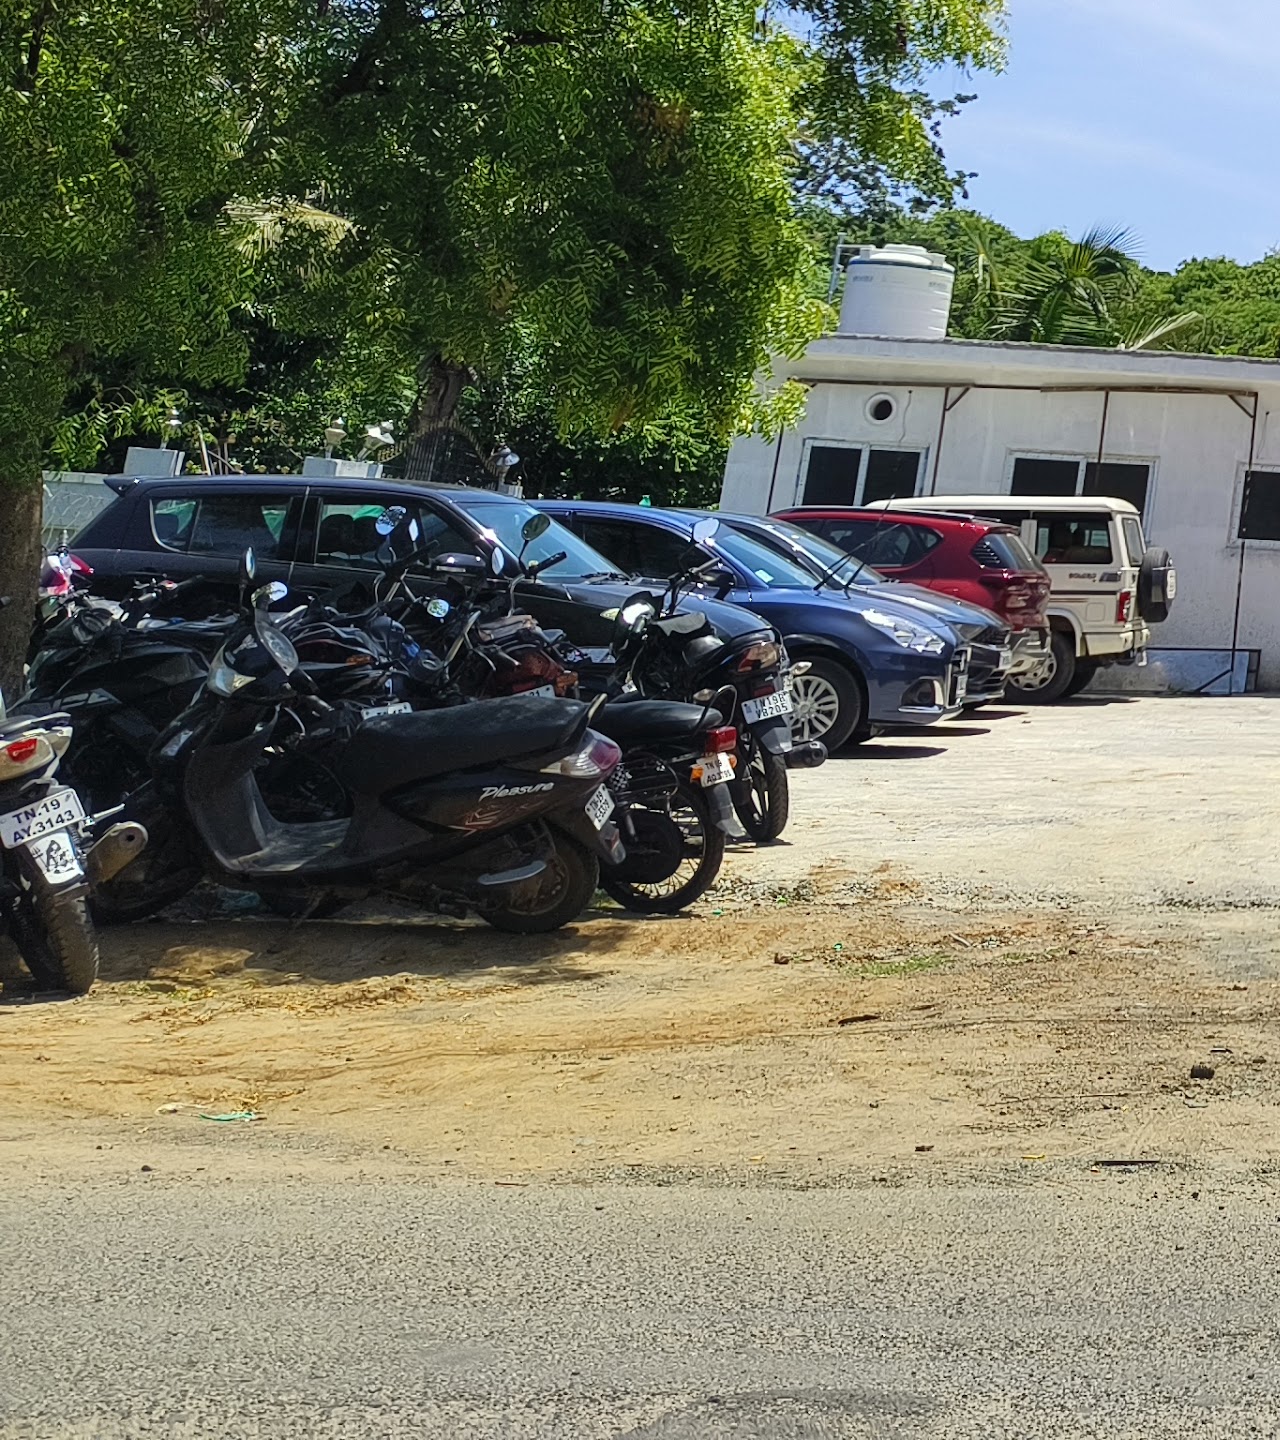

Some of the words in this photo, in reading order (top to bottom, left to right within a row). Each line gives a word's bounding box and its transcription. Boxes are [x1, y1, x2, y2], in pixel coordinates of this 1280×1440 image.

[479, 782, 555, 801] Pleasure
[12, 798, 61, 824] TN.19
[13, 809, 75, 843] AY.3143
